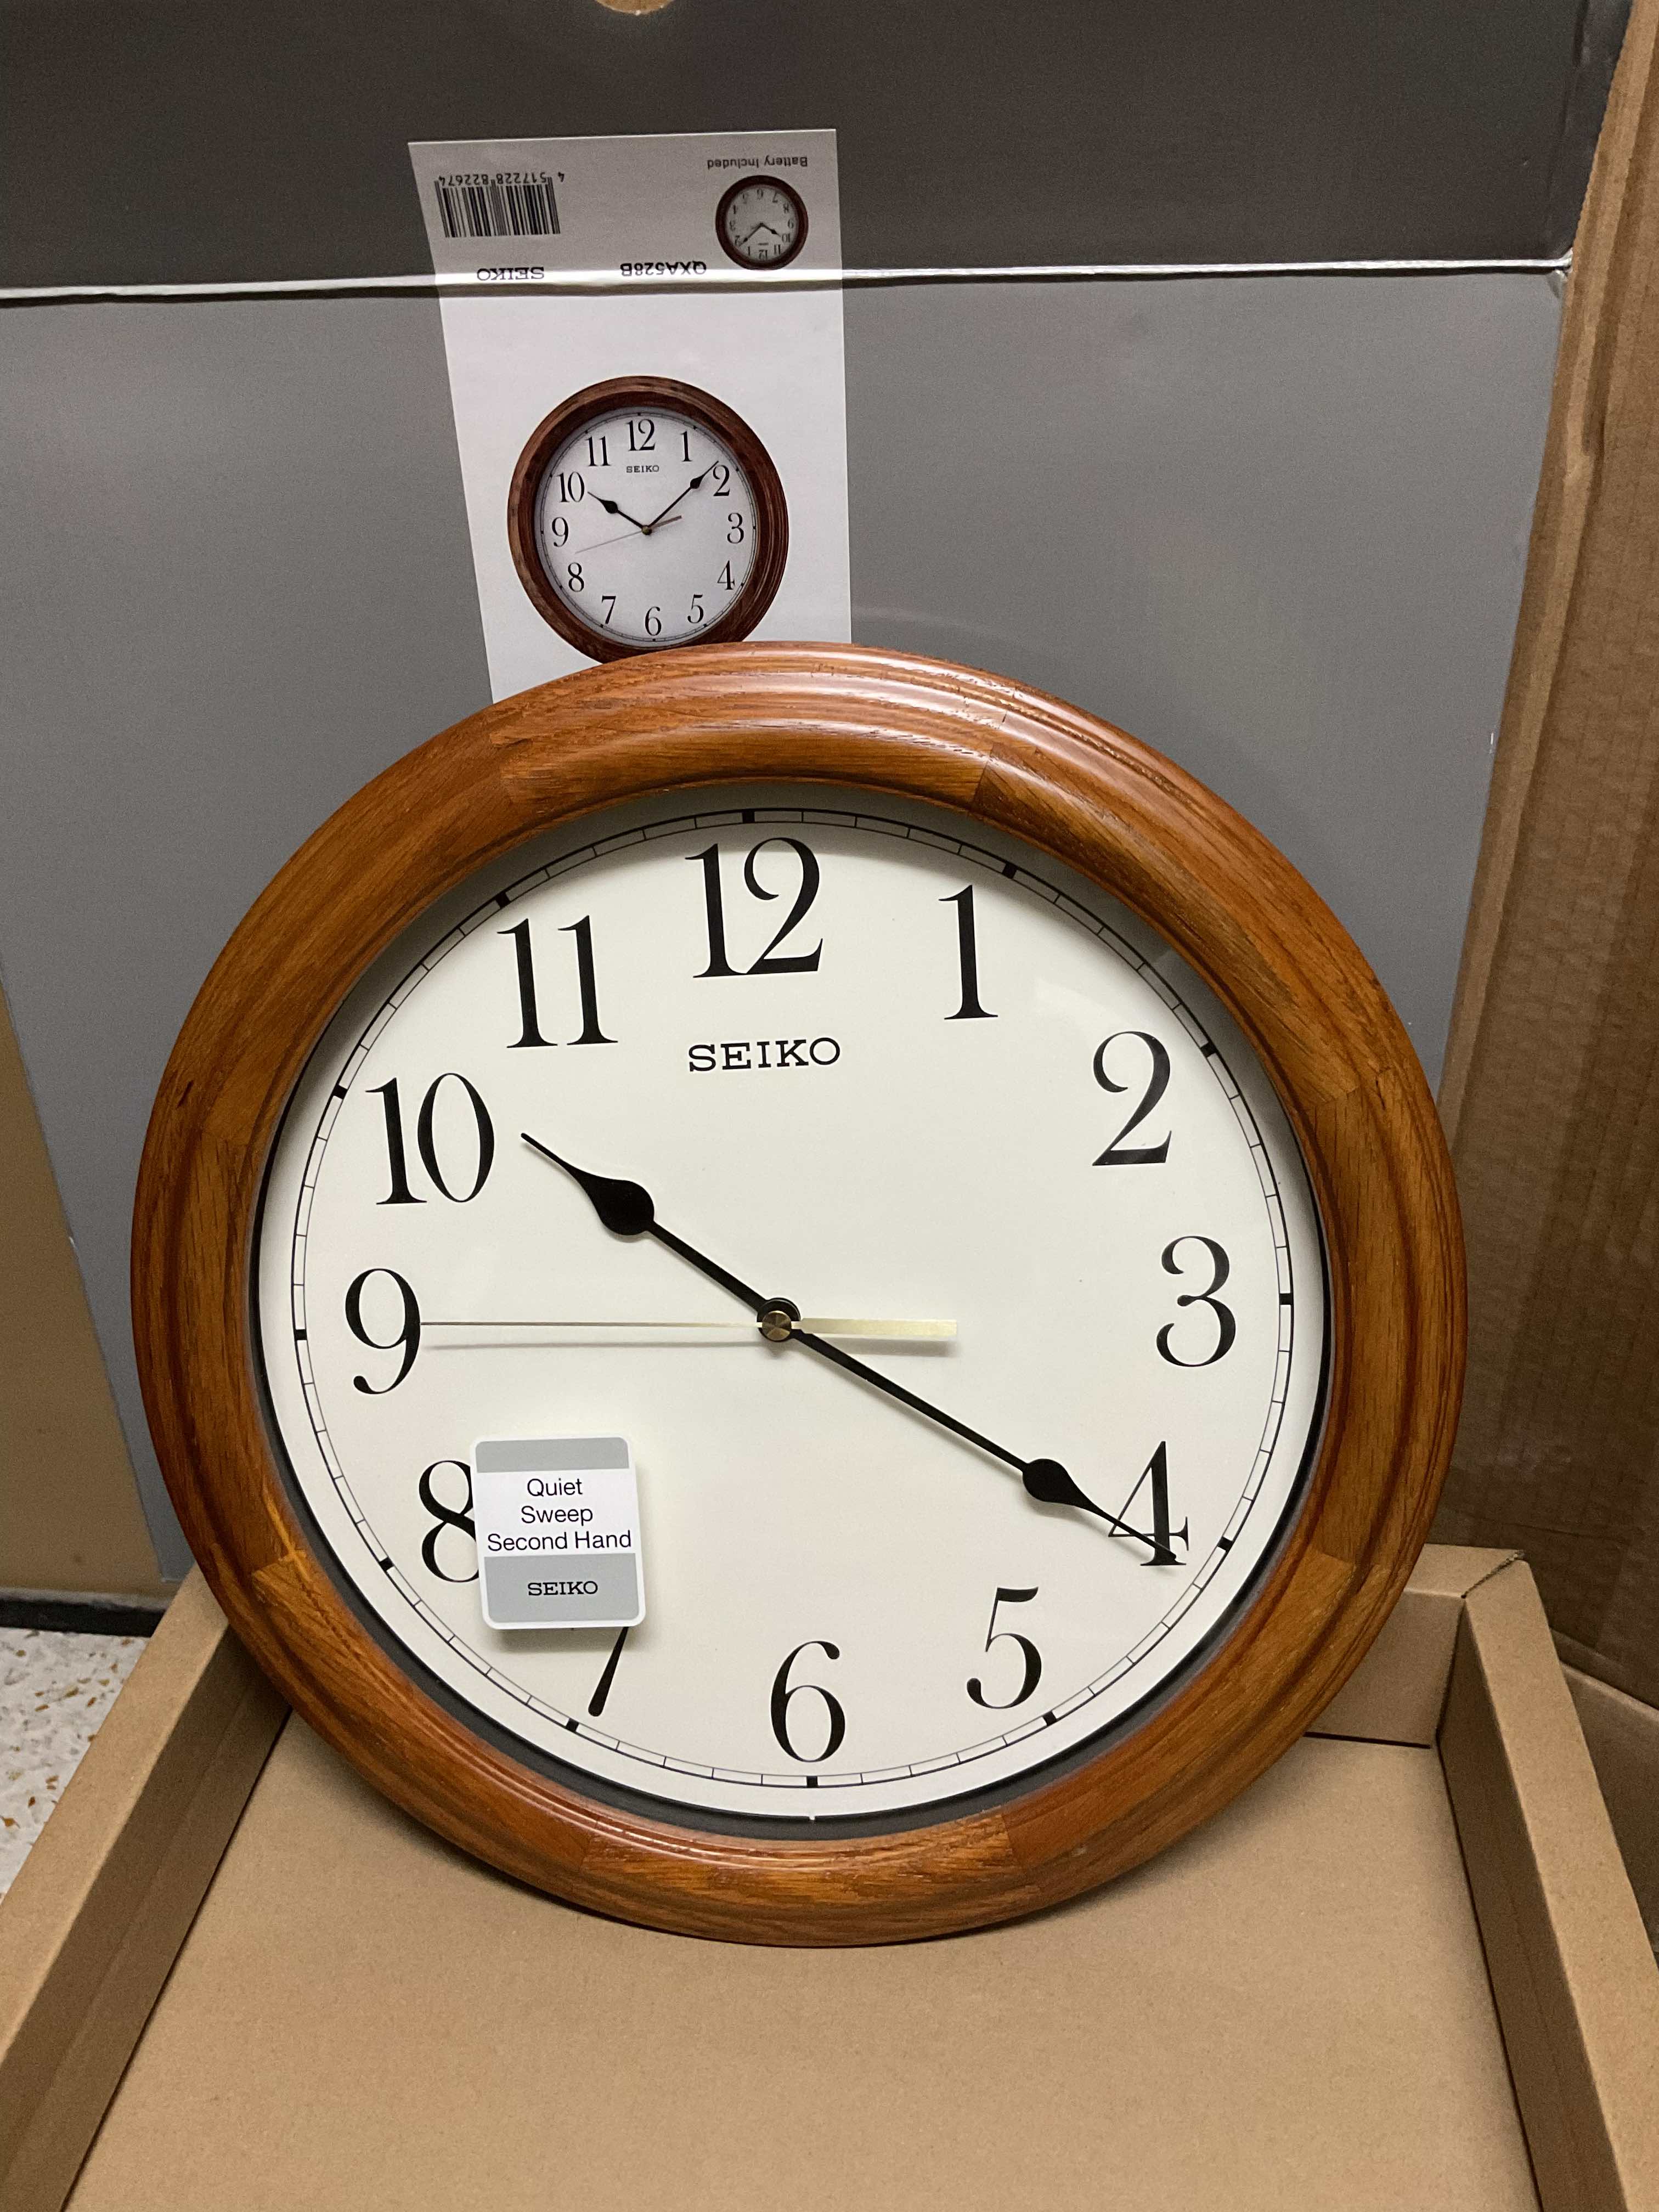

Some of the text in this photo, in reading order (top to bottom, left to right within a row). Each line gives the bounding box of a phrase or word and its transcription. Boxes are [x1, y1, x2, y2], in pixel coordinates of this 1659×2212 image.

[707, 155, 808, 170] Battery Included
[439, 172, 565, 187] 4 517228 822674
[477, 266, 545, 281] SEIKO
[620, 260, 707, 276] QXA528B
[625, 419, 656, 452] 12
[681, 431, 692, 462] 1
[585, 436, 611, 467] 11
[627, 465, 659, 473] SEIKO
[712, 464, 731, 496] 2
[556, 471, 585, 503] 10
[551, 517, 569, 548] 9
[727, 512, 744, 544] 3
[567, 562, 585, 593] 8
[717, 560, 736, 590] 4
[601, 595, 617, 625] 7
[644, 606, 662, 636] 6
[687, 594, 704, 624] 5
[685, 837, 823, 978] 12
[938, 884, 999, 1020] 1
[496, 915, 619, 1049] 11
[688, 1037, 841, 1072] SEIKO
[1092, 1031, 1172, 1166] 2
[365, 1073, 495, 1205] 10
[1156, 1235, 1237, 1368] 3
[345, 1268, 421, 1395] 9
[527, 1477, 583, 1497] Quiet
[521, 1505, 594, 1527] Sweep
[1108, 1440, 1190, 1567] 4
[419, 1460, 479, 1583] 8
[487, 1530, 632, 1552] Second Hand
[527, 1581, 599, 1596] SEIKO
[967, 1587, 1042, 1710] 5
[770, 1641, 846, 1763] 6
